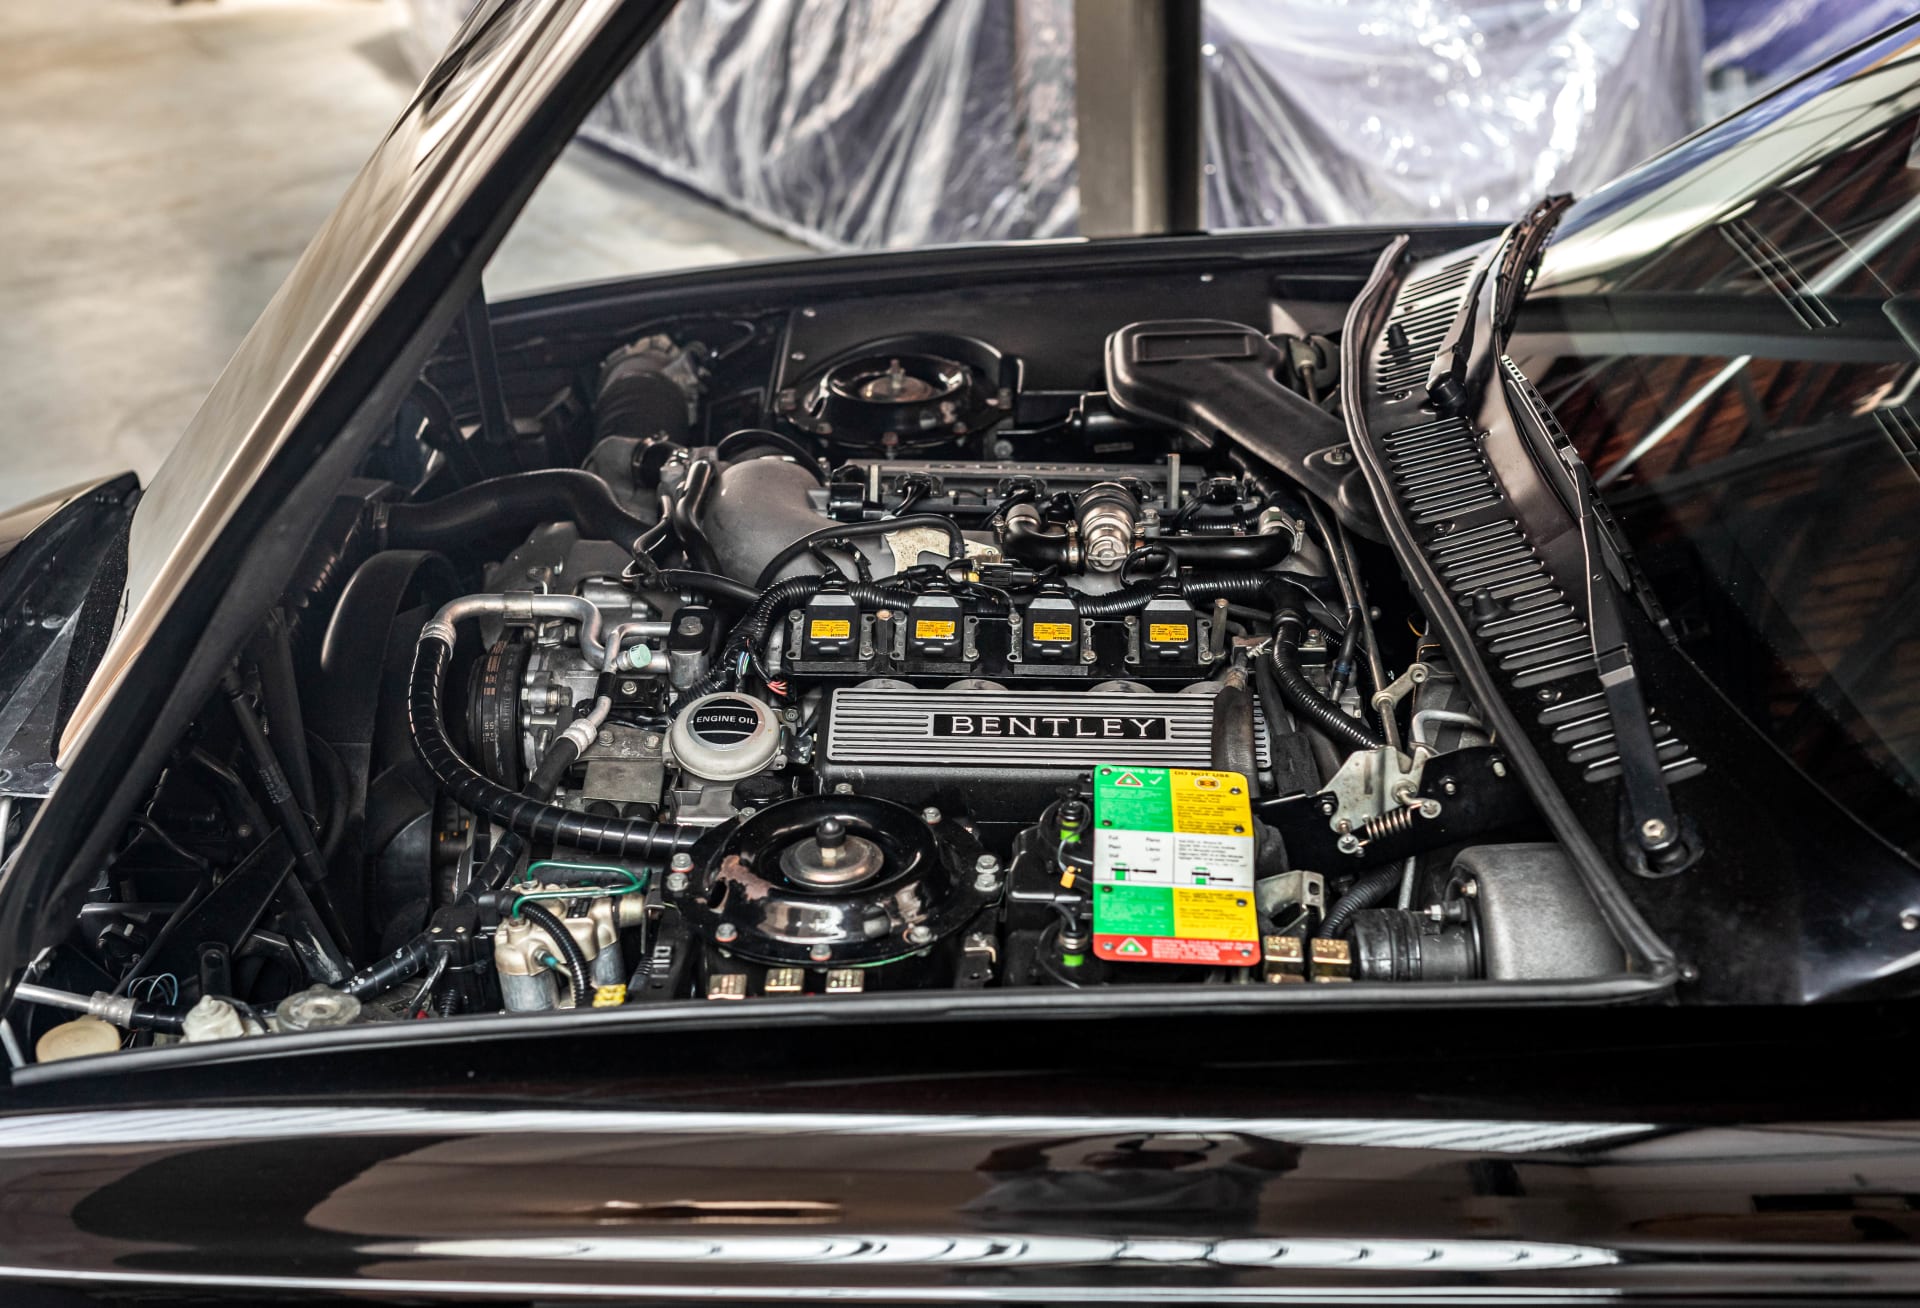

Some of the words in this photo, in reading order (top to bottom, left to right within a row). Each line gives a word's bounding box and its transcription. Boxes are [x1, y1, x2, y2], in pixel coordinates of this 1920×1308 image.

[696, 715, 737, 723] ENGINE
[738, 715, 756, 725] OIL
[951, 716, 1156, 737] BENTLEY
